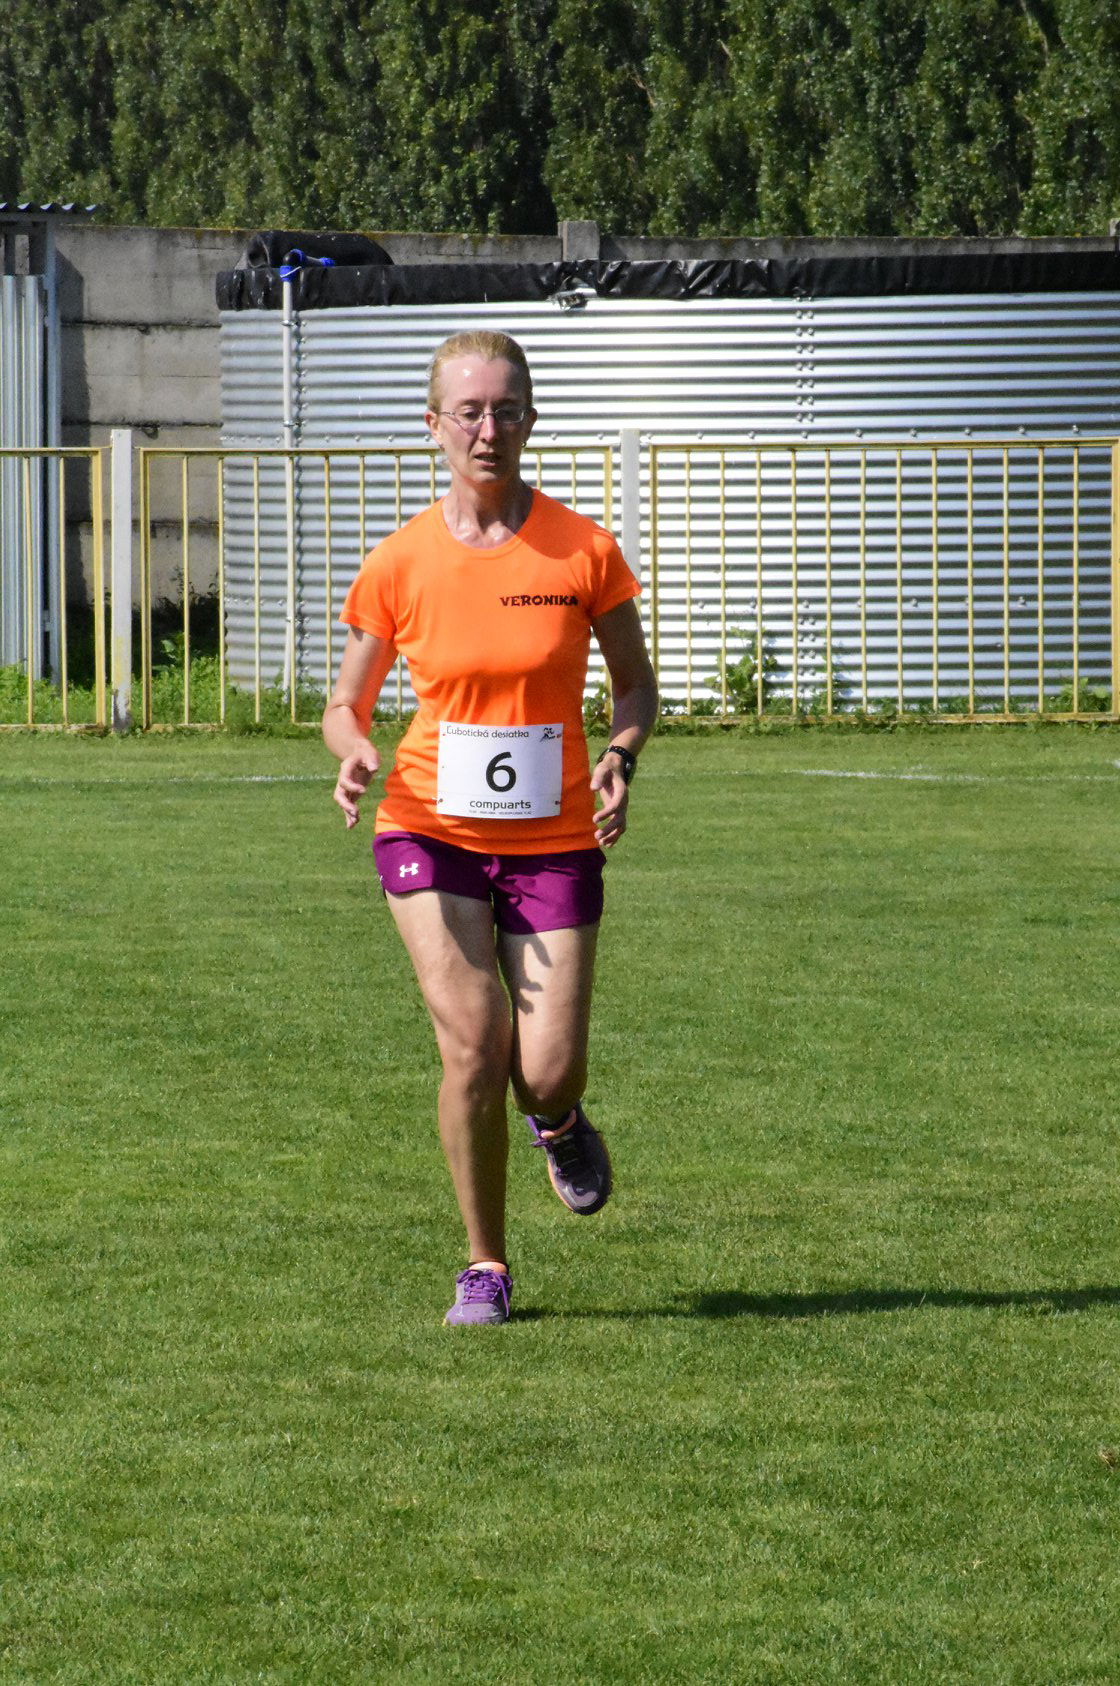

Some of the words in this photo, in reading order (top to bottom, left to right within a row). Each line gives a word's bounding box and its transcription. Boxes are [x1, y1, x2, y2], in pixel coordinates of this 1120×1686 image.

[499, 594, 579, 607] VERONIKA
[491, 729, 530, 738] desiatka
[485, 751, 517, 793] 6
[469, 799, 532, 810] compuarts
